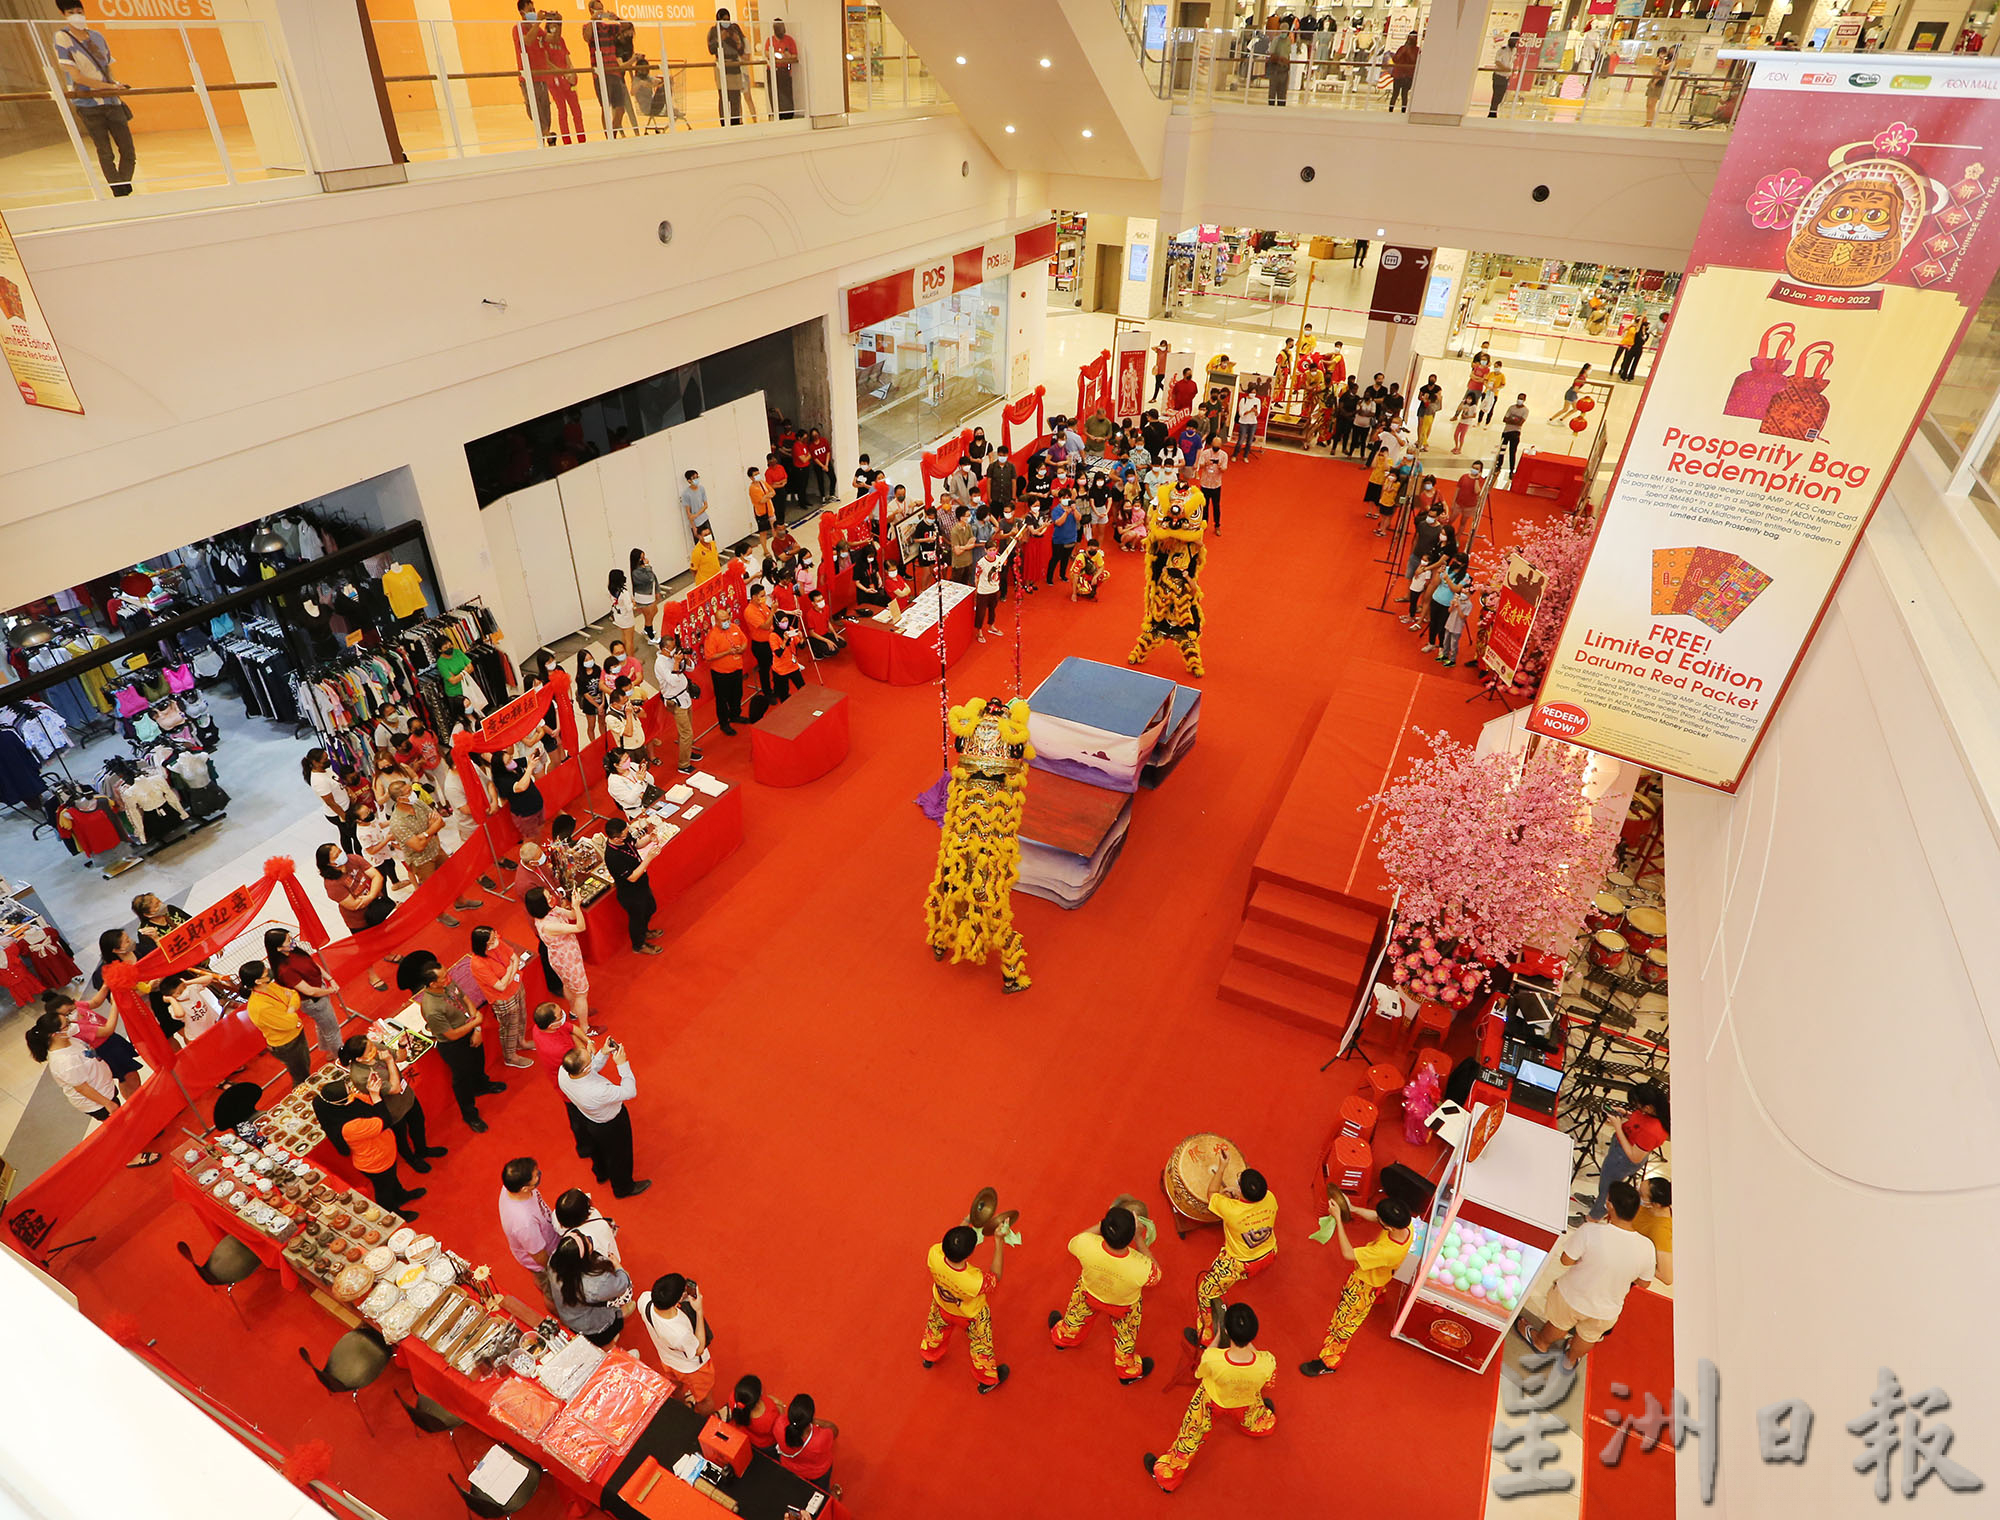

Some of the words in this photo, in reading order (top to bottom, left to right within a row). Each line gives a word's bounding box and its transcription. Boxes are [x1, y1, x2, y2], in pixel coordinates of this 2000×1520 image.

[620, 5, 664, 18] COMING
[667, 5, 694, 18] SOON
[1945, 256, 1962, 283] HAPPY
[1958, 221, 1979, 256] CHINESE
[1975, 200, 1989, 221] NEW
[1986, 176, 2000, 200] YEAR
[922, 265, 945, 292] POS
[986, 254, 999, 270] POS
[1780, 287, 1790, 295] 10
[1790, 290, 1807, 299] Jan
[1814, 294, 1827, 302] 20
[1827, 295, 1846, 304] Feb
[1847, 296, 1871, 304] 2022
[1662, 427, 1803, 471] Prosperity
[1809, 451, 1870, 488] Bag
[1668, 452, 1841, 504] Redemption
[1625, 470, 1648, 479] Spend
[1695, 482, 1716, 492] single
[1717, 486, 1744, 497] receipt
[1745, 491, 1765, 501] using
[1766, 496, 1782, 504] AMP
[1793, 501, 1810, 510] ACS
[1811, 505, 1835, 516] Credit
[1837, 511, 1857, 521] Card
[1631, 479, 1663, 491] payment
[1668, 485, 1692, 495] Spend
[1739, 498, 1761, 508] single
[1762, 503, 1789, 514] receipt
[1790, 509, 1815, 520] (AEON
[1815, 515, 1852, 530] Member)
[1645, 489, 1668, 499] Spend
[1714, 501, 1736, 512] single
[1737, 506, 1764, 518] receipt
[1765, 512, 1783, 522] (Non
[1784, 517, 1821, 533] -Member)
[1638, 496, 1652, 504] any
[1653, 499, 1680, 509] partner
[1689, 505, 1709, 514] AEON
[1710, 509, 1742, 521] Midtown
[1743, 517, 1762, 526] Falim
[1763, 522, 1792, 533] entitled
[1801, 531, 1832, 544] redeem
[1669, 510, 1696, 521] Limited
[1697, 516, 1723, 525] Edition
[1724, 521, 1761, 535] Prosperity
[1762, 529, 1780, 540] bag
[1648, 624, 1712, 655] FREE!
[1575, 650, 1646, 678] Daruma
[1650, 669, 1688, 690] Red
[1691, 681, 1759, 711] Packet
[1584, 629, 1674, 664] Limited
[1678, 652, 1763, 693] Edition
[1542, 706, 1585, 726] REDEEM
[1544, 718, 1576, 734] NOW!
[1583, 697, 1607, 708] Limited
[1608, 704, 1630, 714] Edition
[1631, 710, 1657, 722] Daruma
[1659, 718, 1682, 730] Money
[1683, 726, 1708, 738] packet
